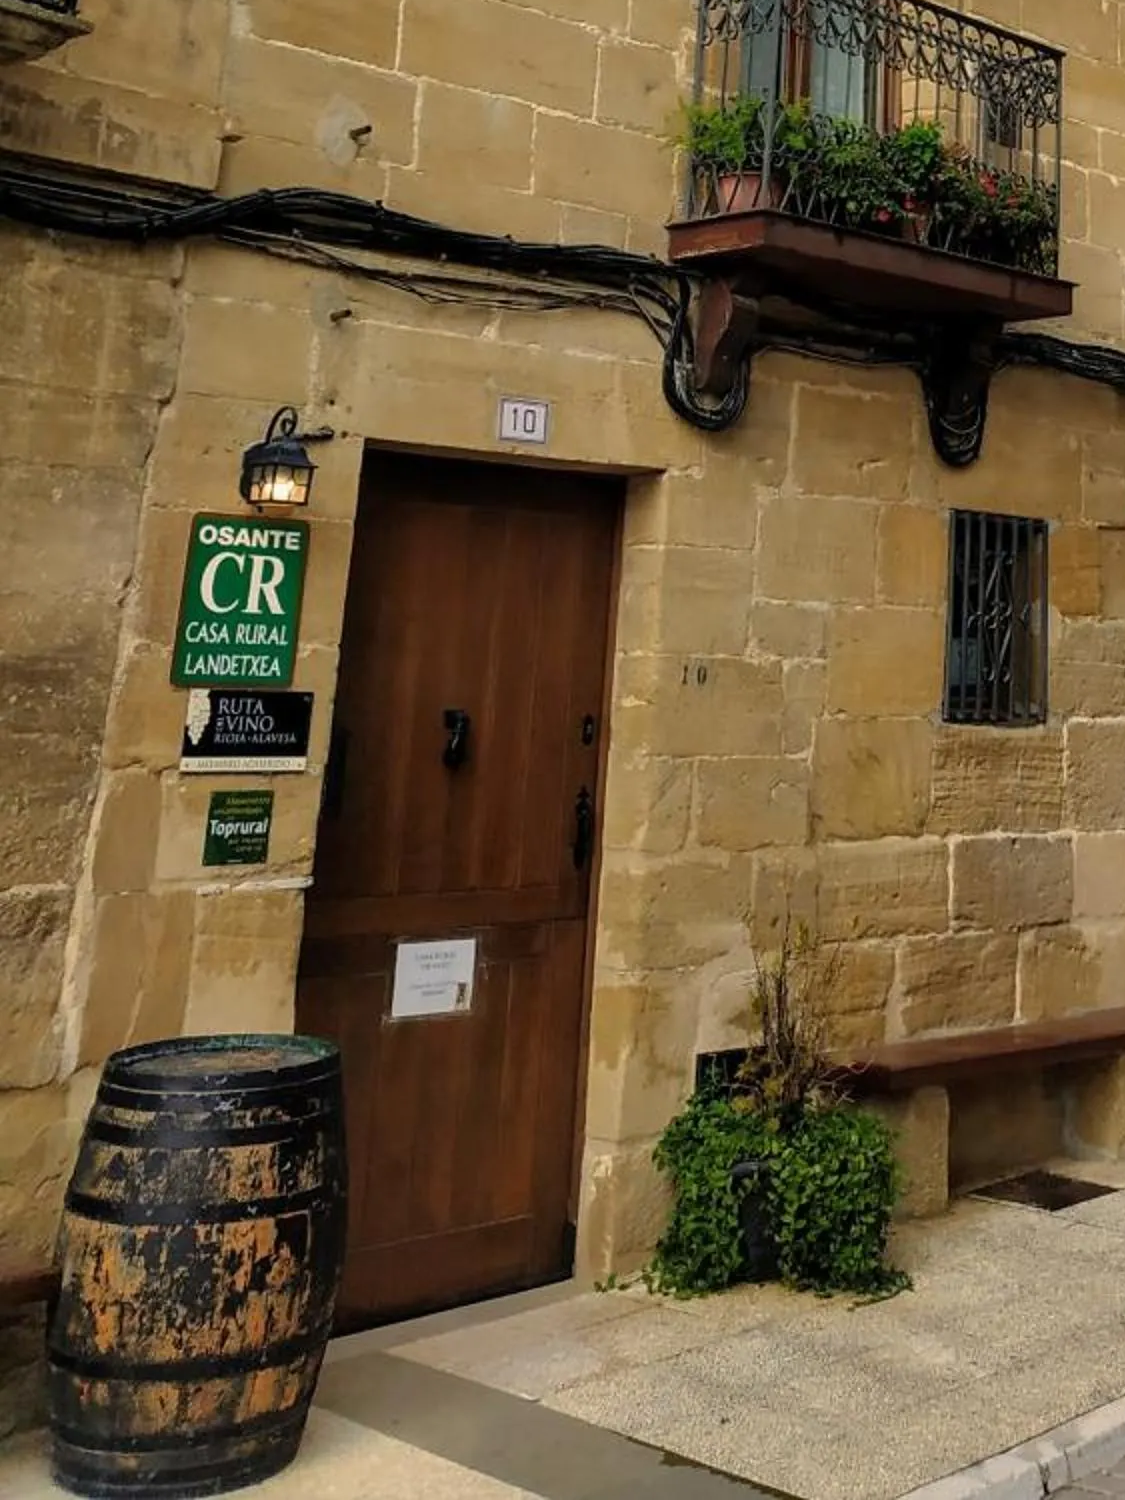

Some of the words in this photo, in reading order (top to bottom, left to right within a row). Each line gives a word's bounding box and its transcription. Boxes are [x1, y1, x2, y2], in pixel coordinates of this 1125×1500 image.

[512, 407, 537, 433] 10
[199, 524, 301, 550] OSANTE
[200, 551, 285, 615] CR
[185, 621, 231, 644] CASA
[235, 622, 289, 646] RURAL
[184, 653, 281, 677] LANDETXEA
[682, 664, 707, 685] 10
[218, 697, 265, 715] RUTA
[226, 715, 275, 733] VINO
[210, 817, 269, 838] Toprural
